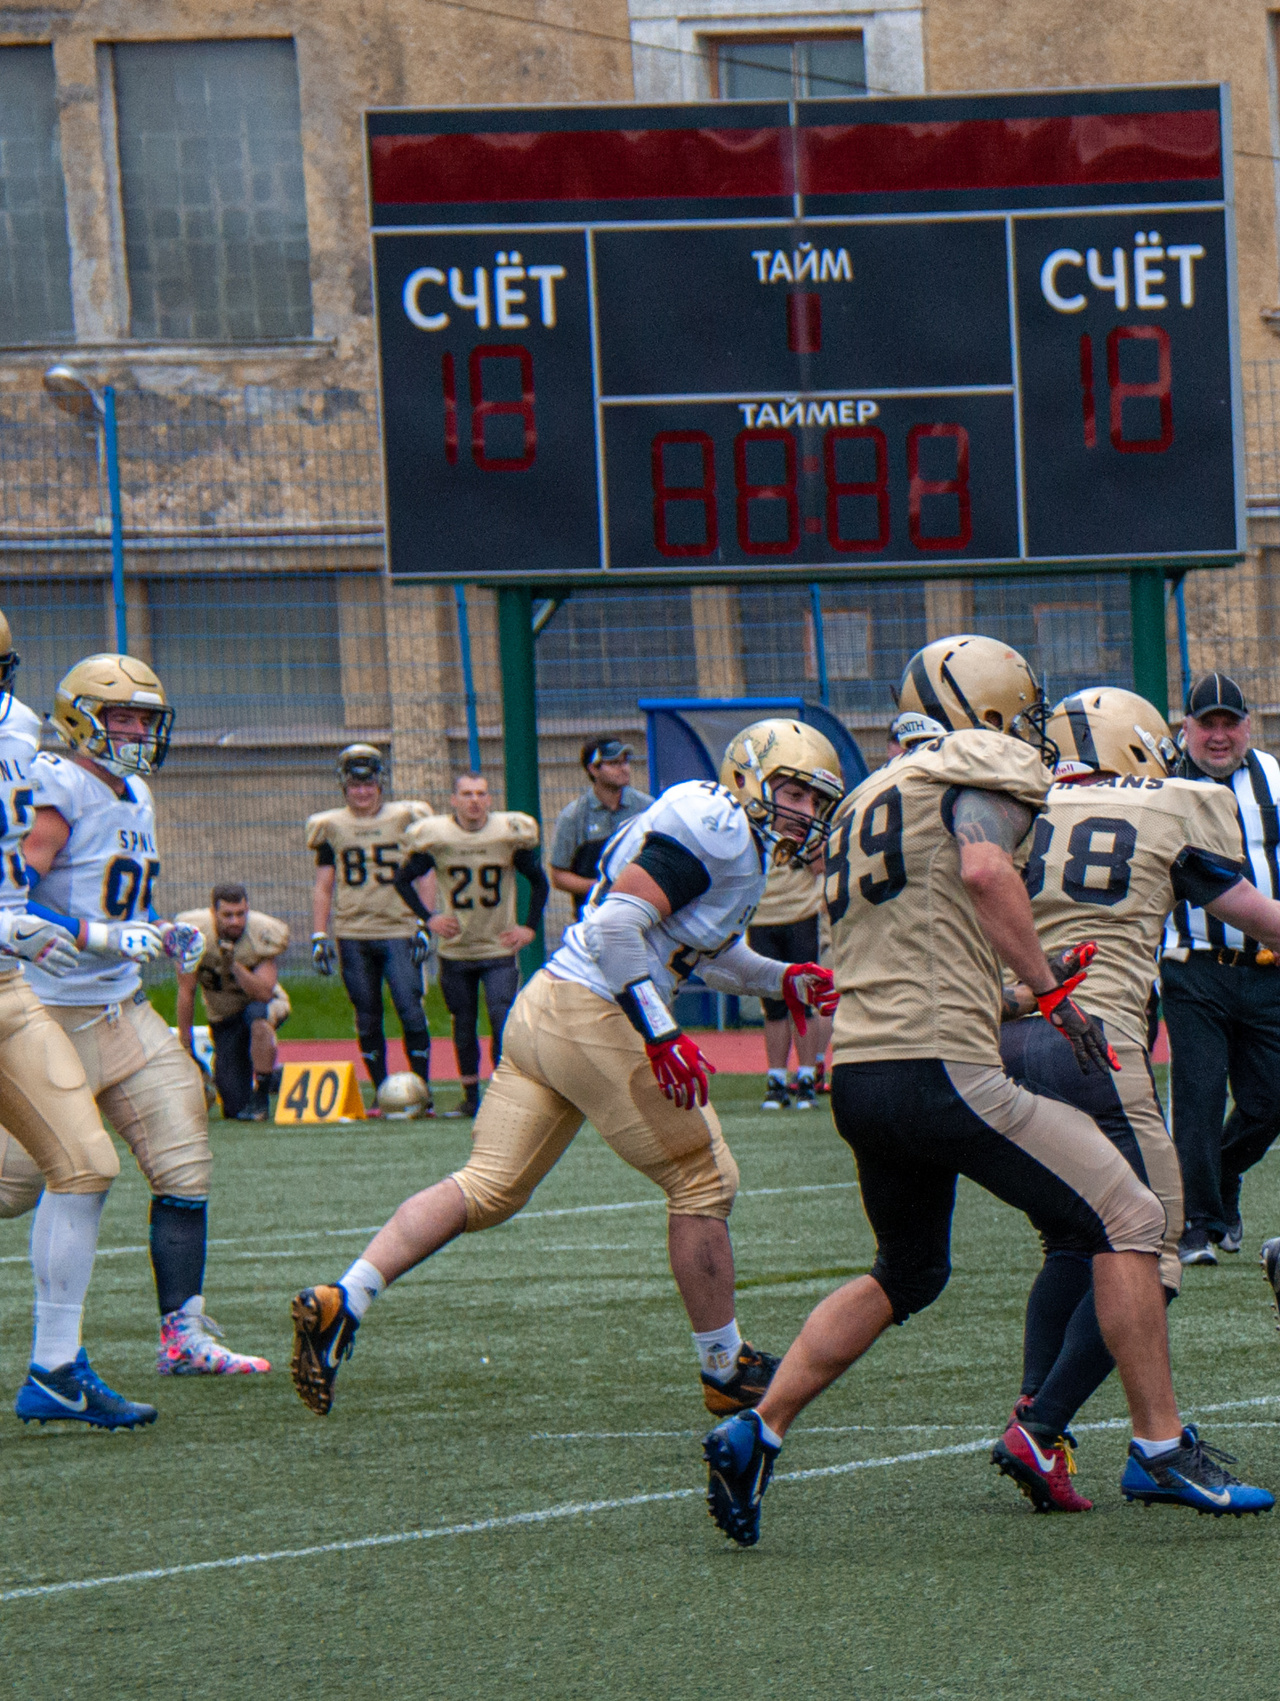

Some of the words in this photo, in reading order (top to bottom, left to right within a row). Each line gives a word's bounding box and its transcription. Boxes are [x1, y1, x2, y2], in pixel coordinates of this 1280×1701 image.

[751, 242, 854, 283] ТАЙМ
[1040, 230, 1206, 314] СЧЁТ
[402, 250, 567, 332] СЧЁТ
[442, 344, 537, 472] 18
[738, 398, 880, 428] ТАЙМЕР
[1079, 325, 1174, 453] 18
[899, 720, 926, 735] ENITH
[341, 843, 400, 886] 85
[448, 864, 502, 909] 29
[284, 1068, 339, 1120] 40
